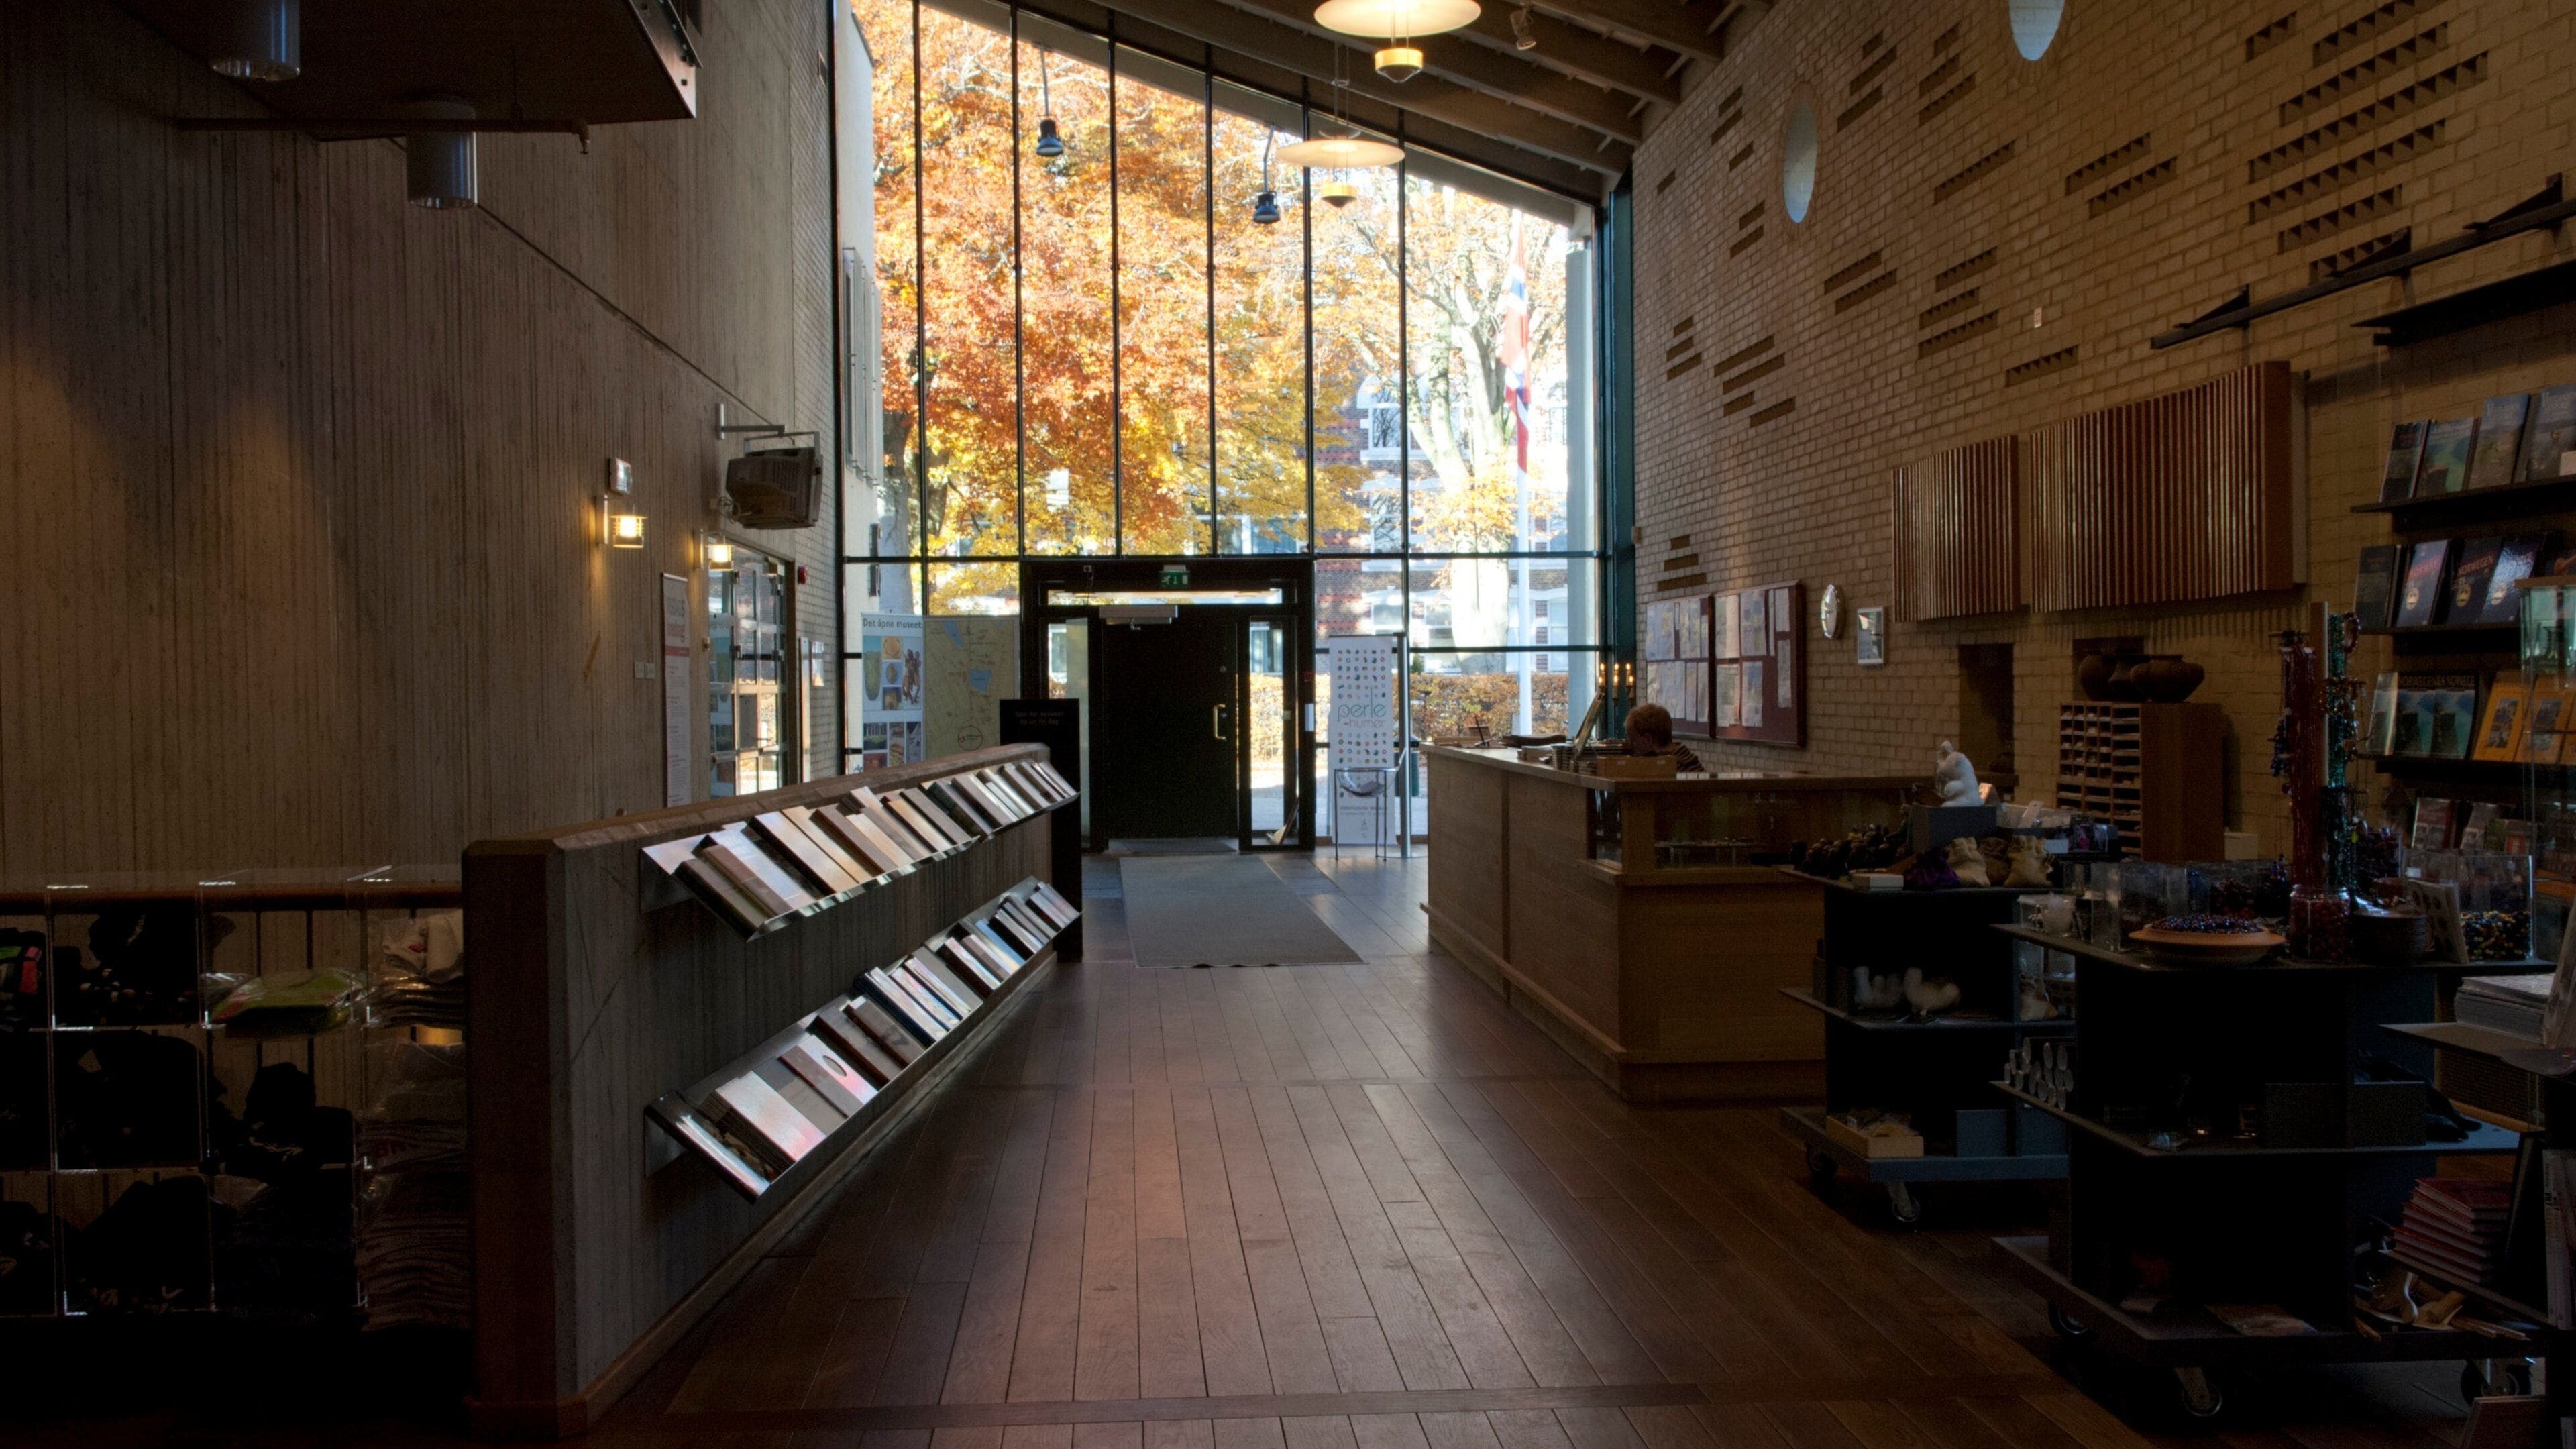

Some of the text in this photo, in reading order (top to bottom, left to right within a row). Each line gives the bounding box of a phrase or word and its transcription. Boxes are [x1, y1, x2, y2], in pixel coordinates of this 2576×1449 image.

[863, 618, 922, 629] Det åpne museet
[1337, 685, 1387, 722] perle
